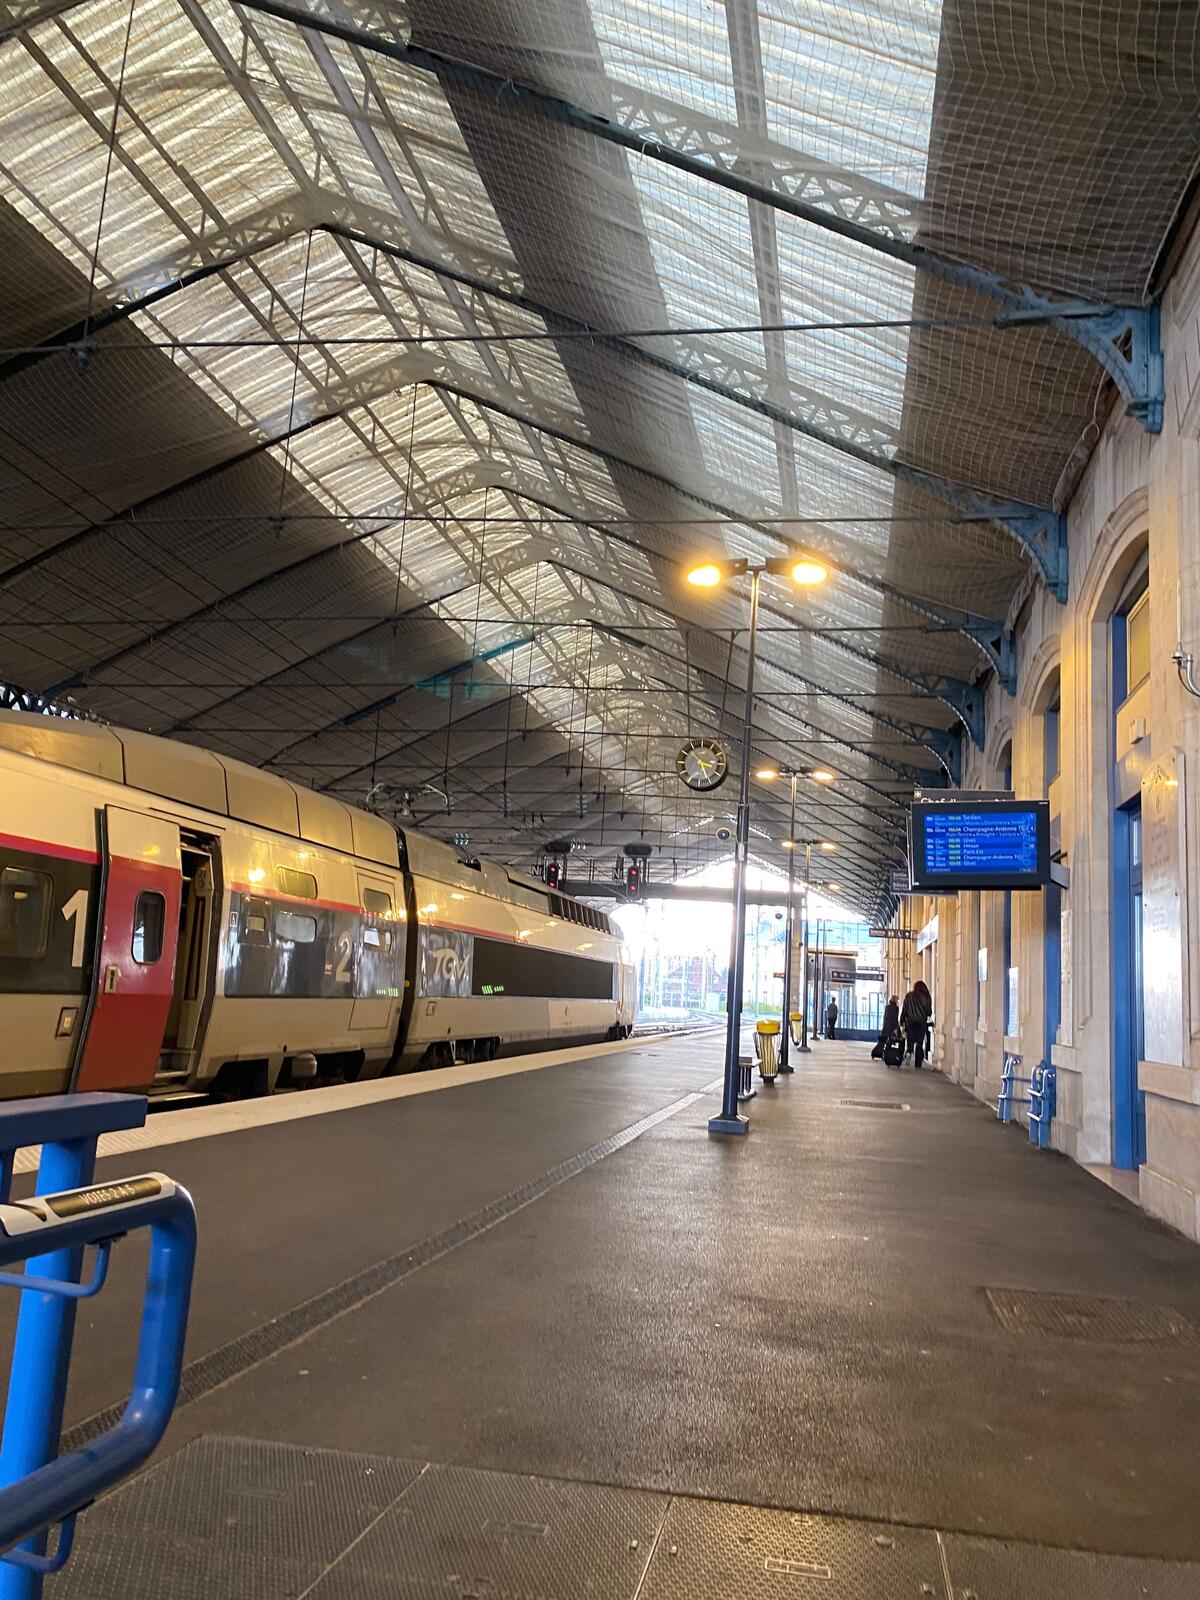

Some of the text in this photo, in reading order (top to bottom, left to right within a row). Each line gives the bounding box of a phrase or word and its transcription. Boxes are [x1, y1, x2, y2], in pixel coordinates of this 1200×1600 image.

[62, 889, 88, 968] 1
[336, 931, 351, 982] 2
[430, 948, 470, 981] TGV
[78, 1190, 112, 1204] VOIES
[109, 1188, 120, 1198] 2
